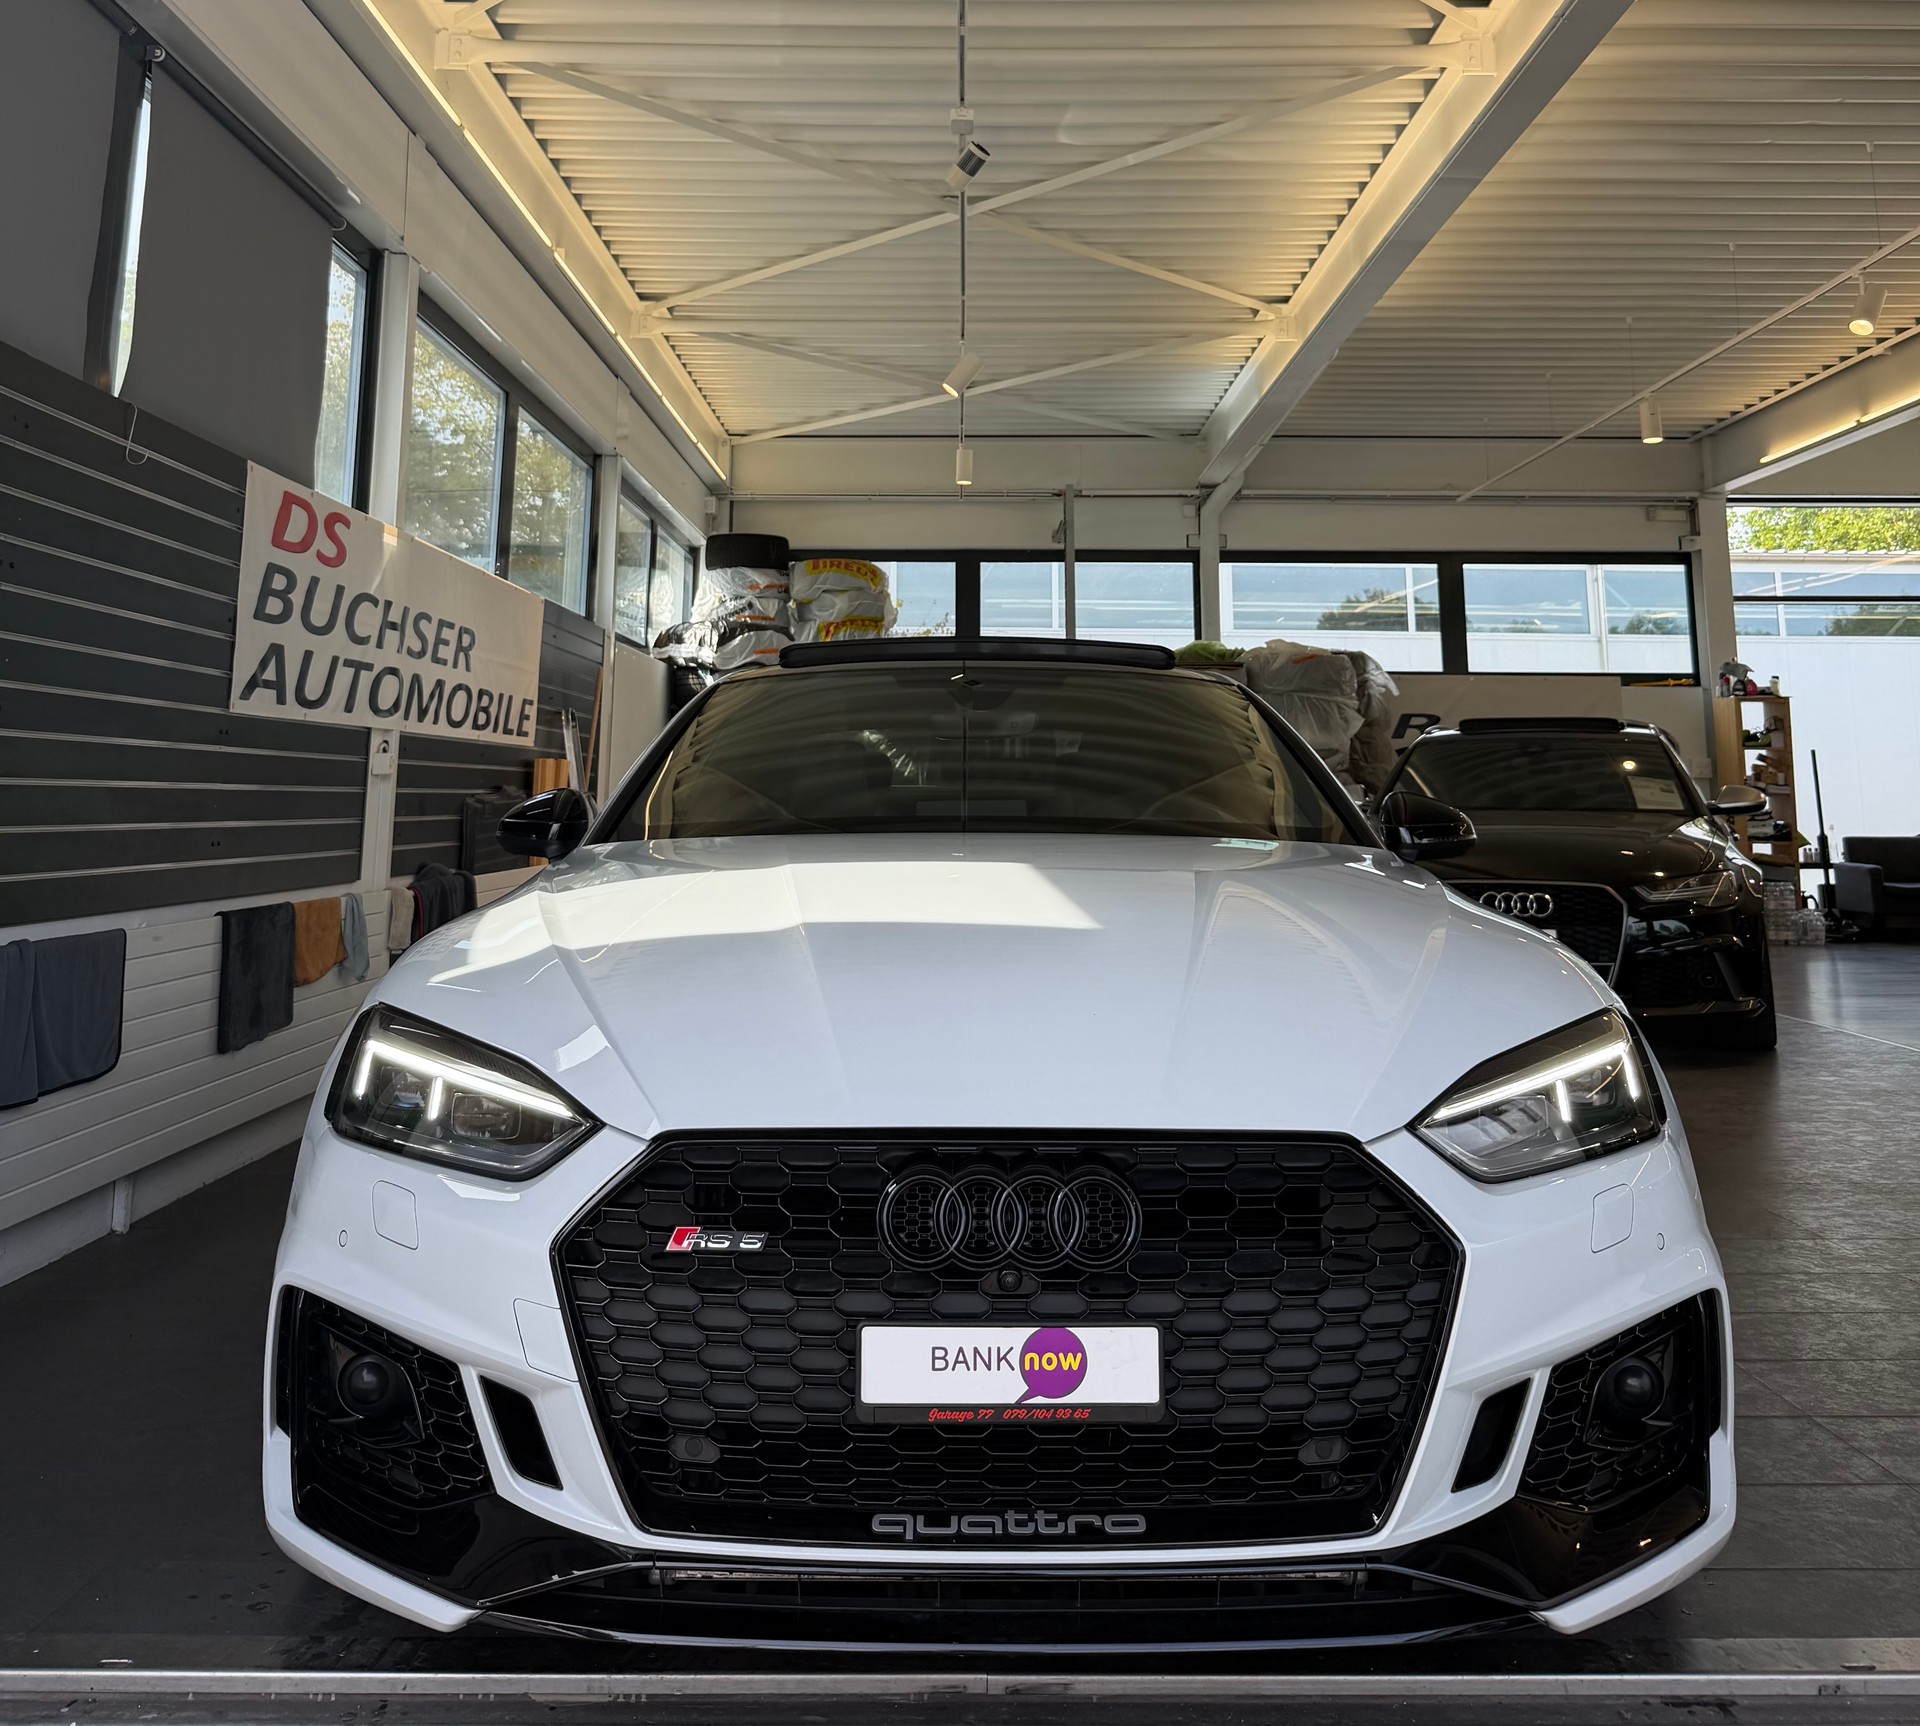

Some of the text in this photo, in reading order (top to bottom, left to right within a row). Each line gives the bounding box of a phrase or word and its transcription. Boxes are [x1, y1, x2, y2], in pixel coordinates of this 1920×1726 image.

[271, 490, 351, 568] DS
[253, 562, 476, 672] BUCHSER
[239, 642, 534, 738] AUTOMOBILE
[681, 1232, 733, 1248] RS
[931, 1346, 1082, 1371] BANK now
[928, 1408, 1091, 1422] Garage 77 079/104 93 65
[872, 1510, 1147, 1540] quattro
